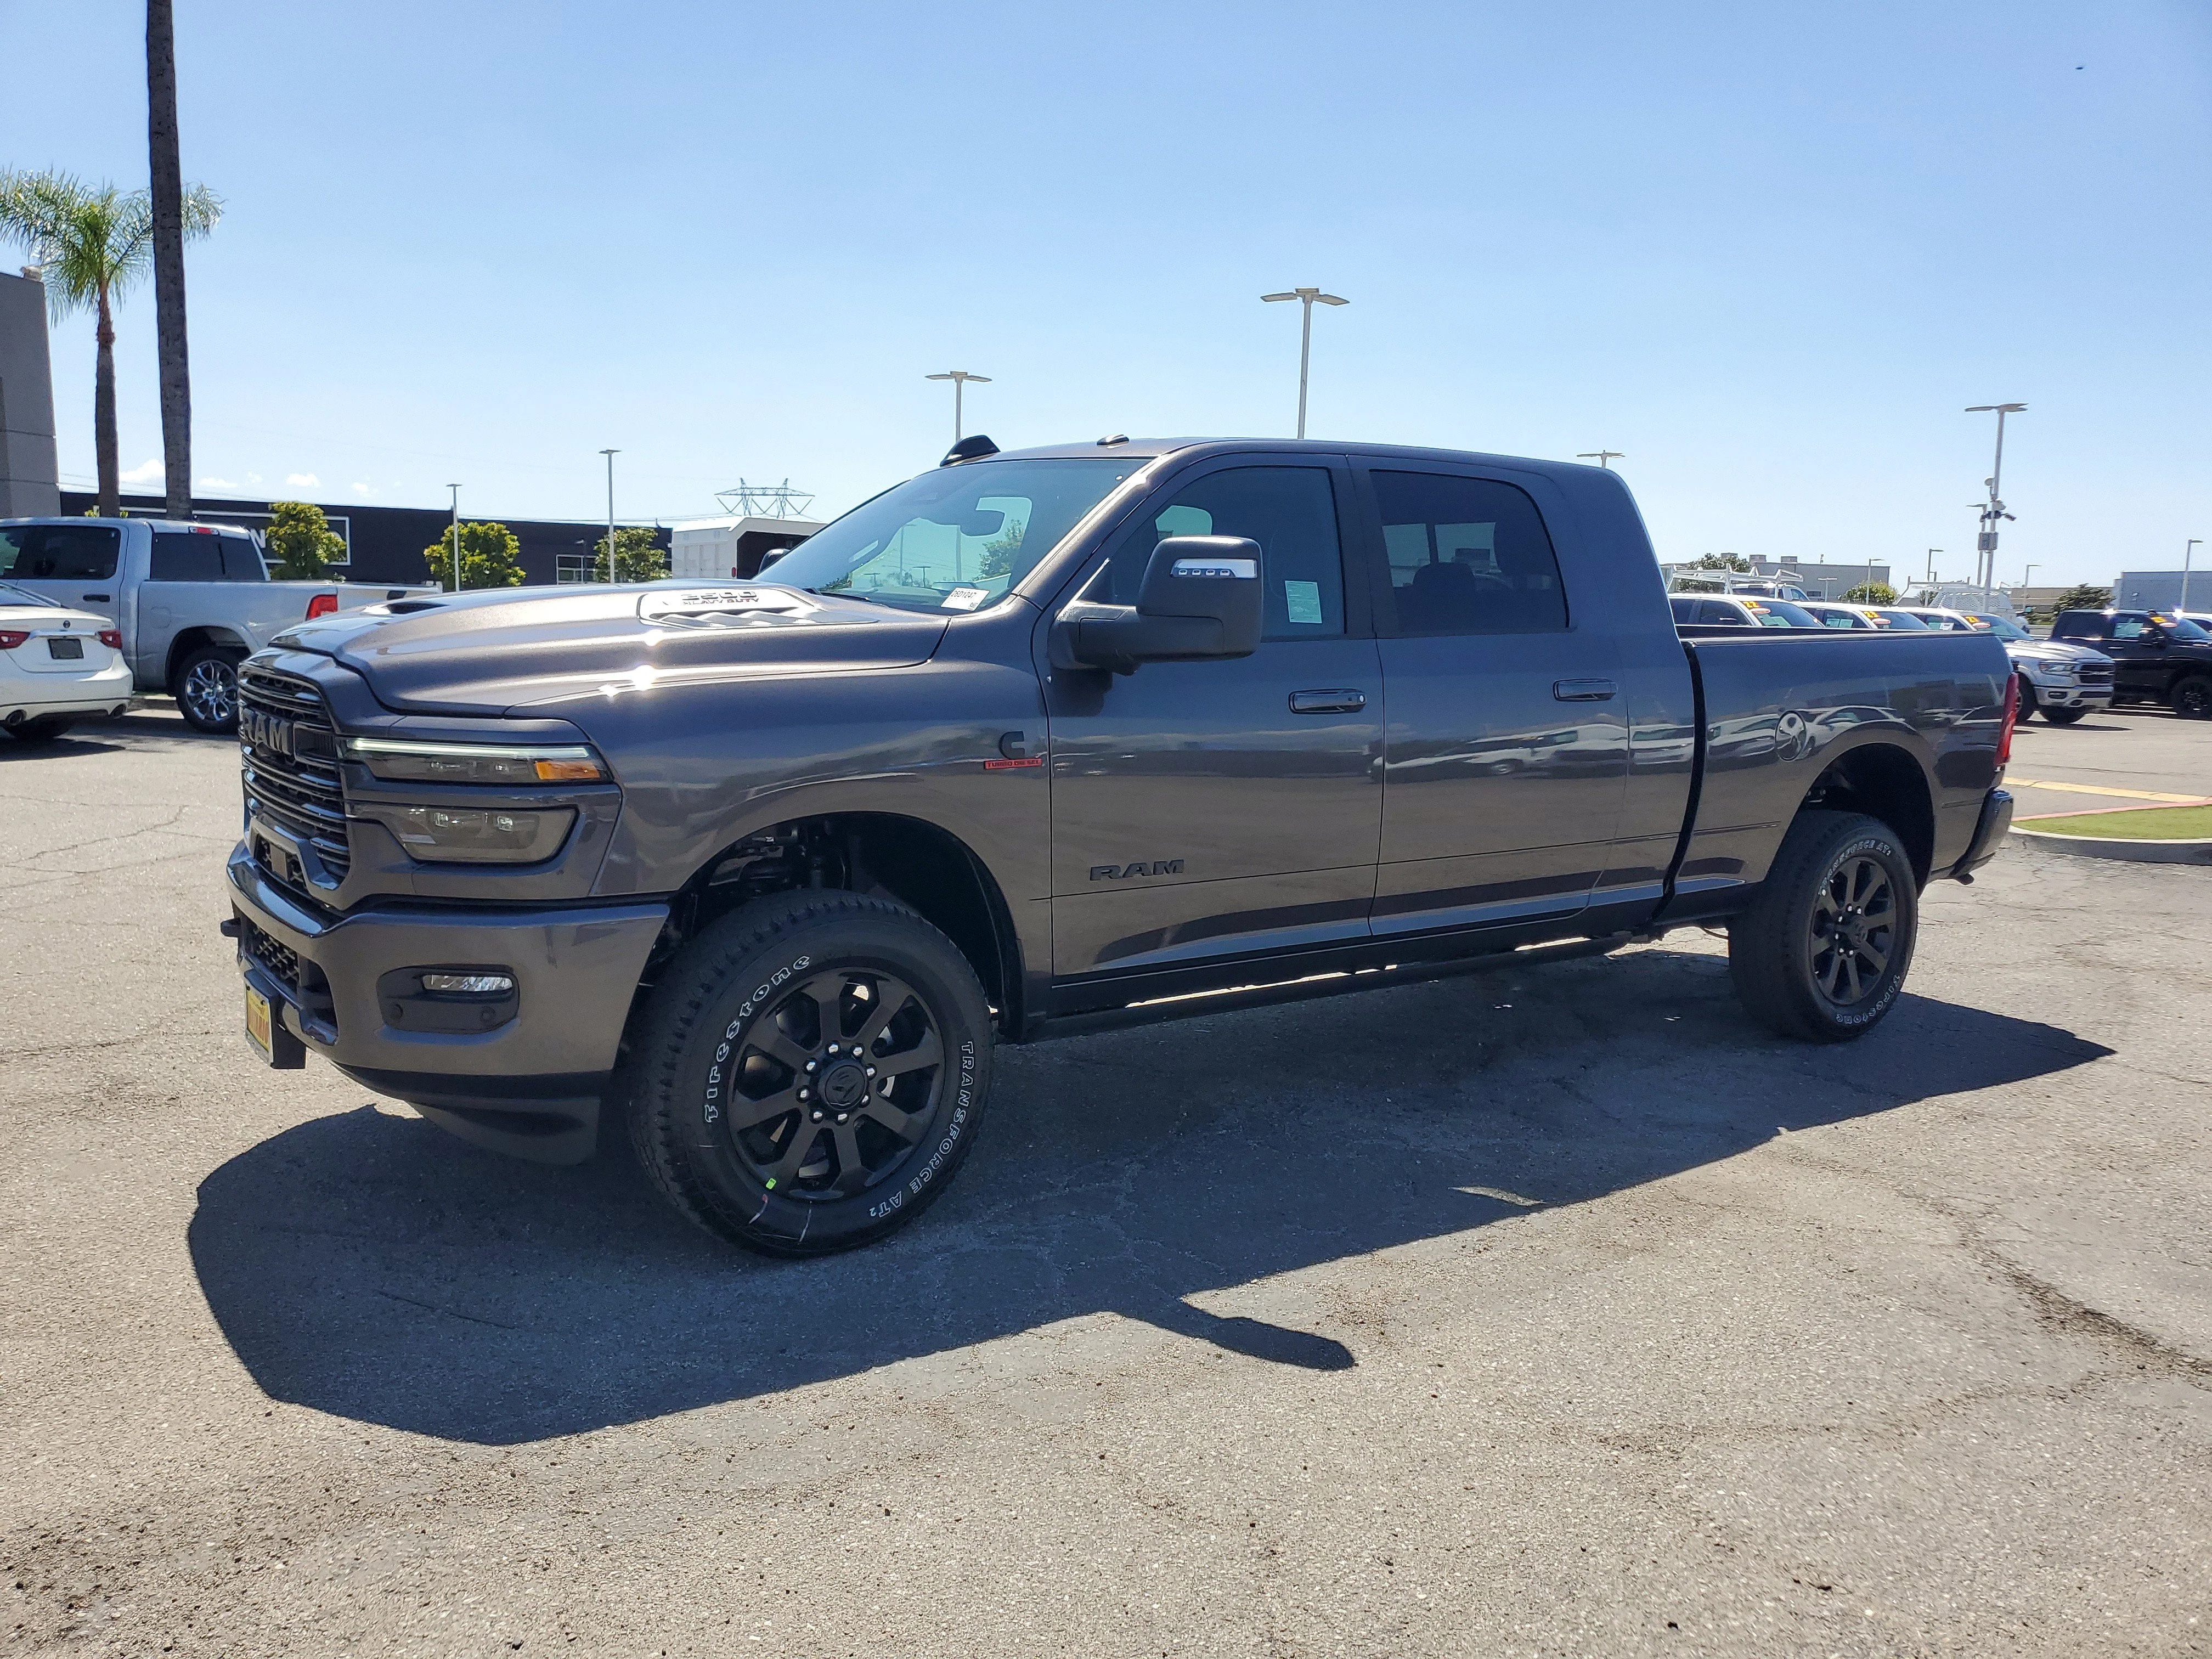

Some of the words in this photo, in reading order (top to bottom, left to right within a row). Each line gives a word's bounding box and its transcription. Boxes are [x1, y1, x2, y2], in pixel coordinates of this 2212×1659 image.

[242, 708, 292, 755] RAM
[1090, 859, 1184, 881] RAM
[909, 1041, 974, 1193] TRANSFORCE
